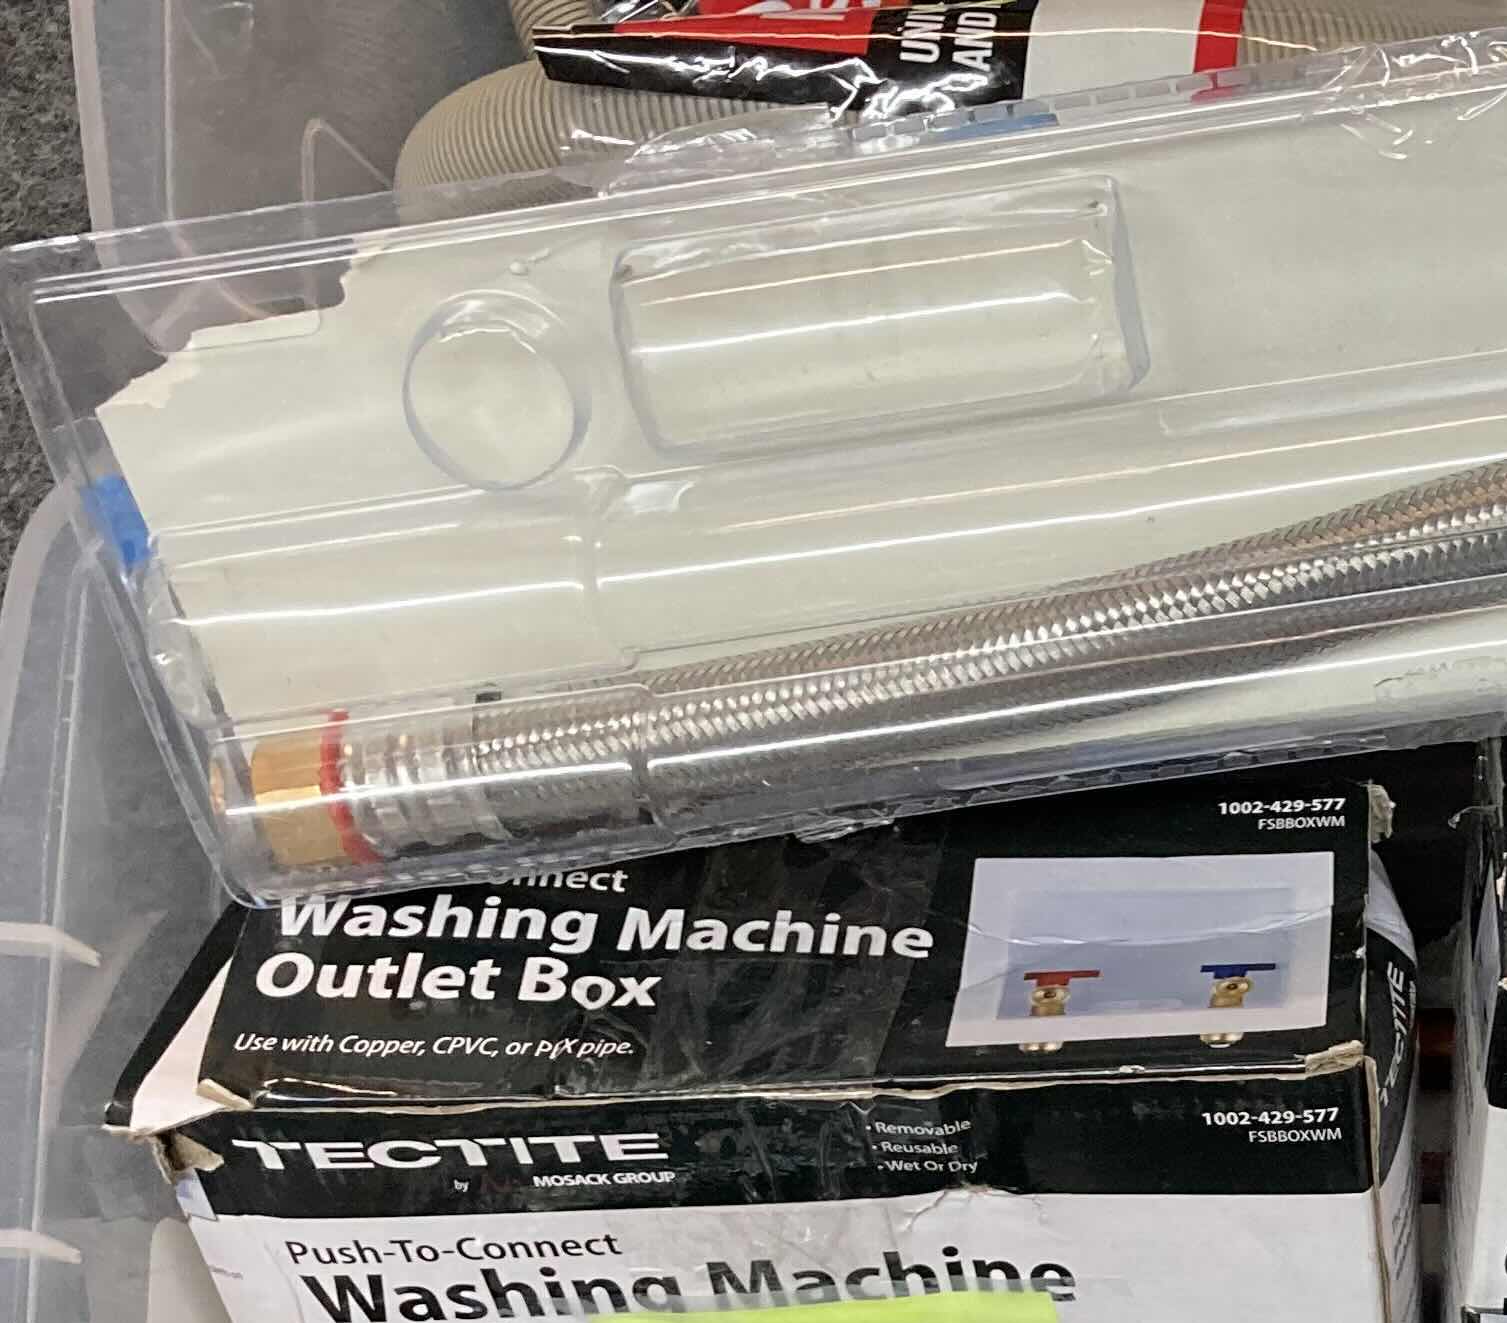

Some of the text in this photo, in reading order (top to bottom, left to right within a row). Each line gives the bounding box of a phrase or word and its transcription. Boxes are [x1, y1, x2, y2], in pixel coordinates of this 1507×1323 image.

[952, 12, 997, 72] AND
[1218, 797, 1345, 815] 1002-429-577
[1257, 815, 1345, 831] FSBBOXWM
[280, 894, 934, 959] Washing Machine
[256, 952, 662, 1010] Outlet Box
[234, 1033, 634, 1059] Use with Copper, CPVC, pipe.
[1202, 1107, 1340, 1126] 1002-429-577
[875, 1117, 972, 1137] Removable
[1249, 1128, 1342, 1143] FSBBOXWM
[232, 1133, 669, 1171] TECTITE
[881, 1140, 958, 1157] Reusable
[886, 1158, 978, 1177] Wet Dry
[533, 1170, 676, 1188] MOSACK GROUP
[284, 1233, 622, 1265] Push-To-Connect
[705, 1246, 1077, 1302] Machine
